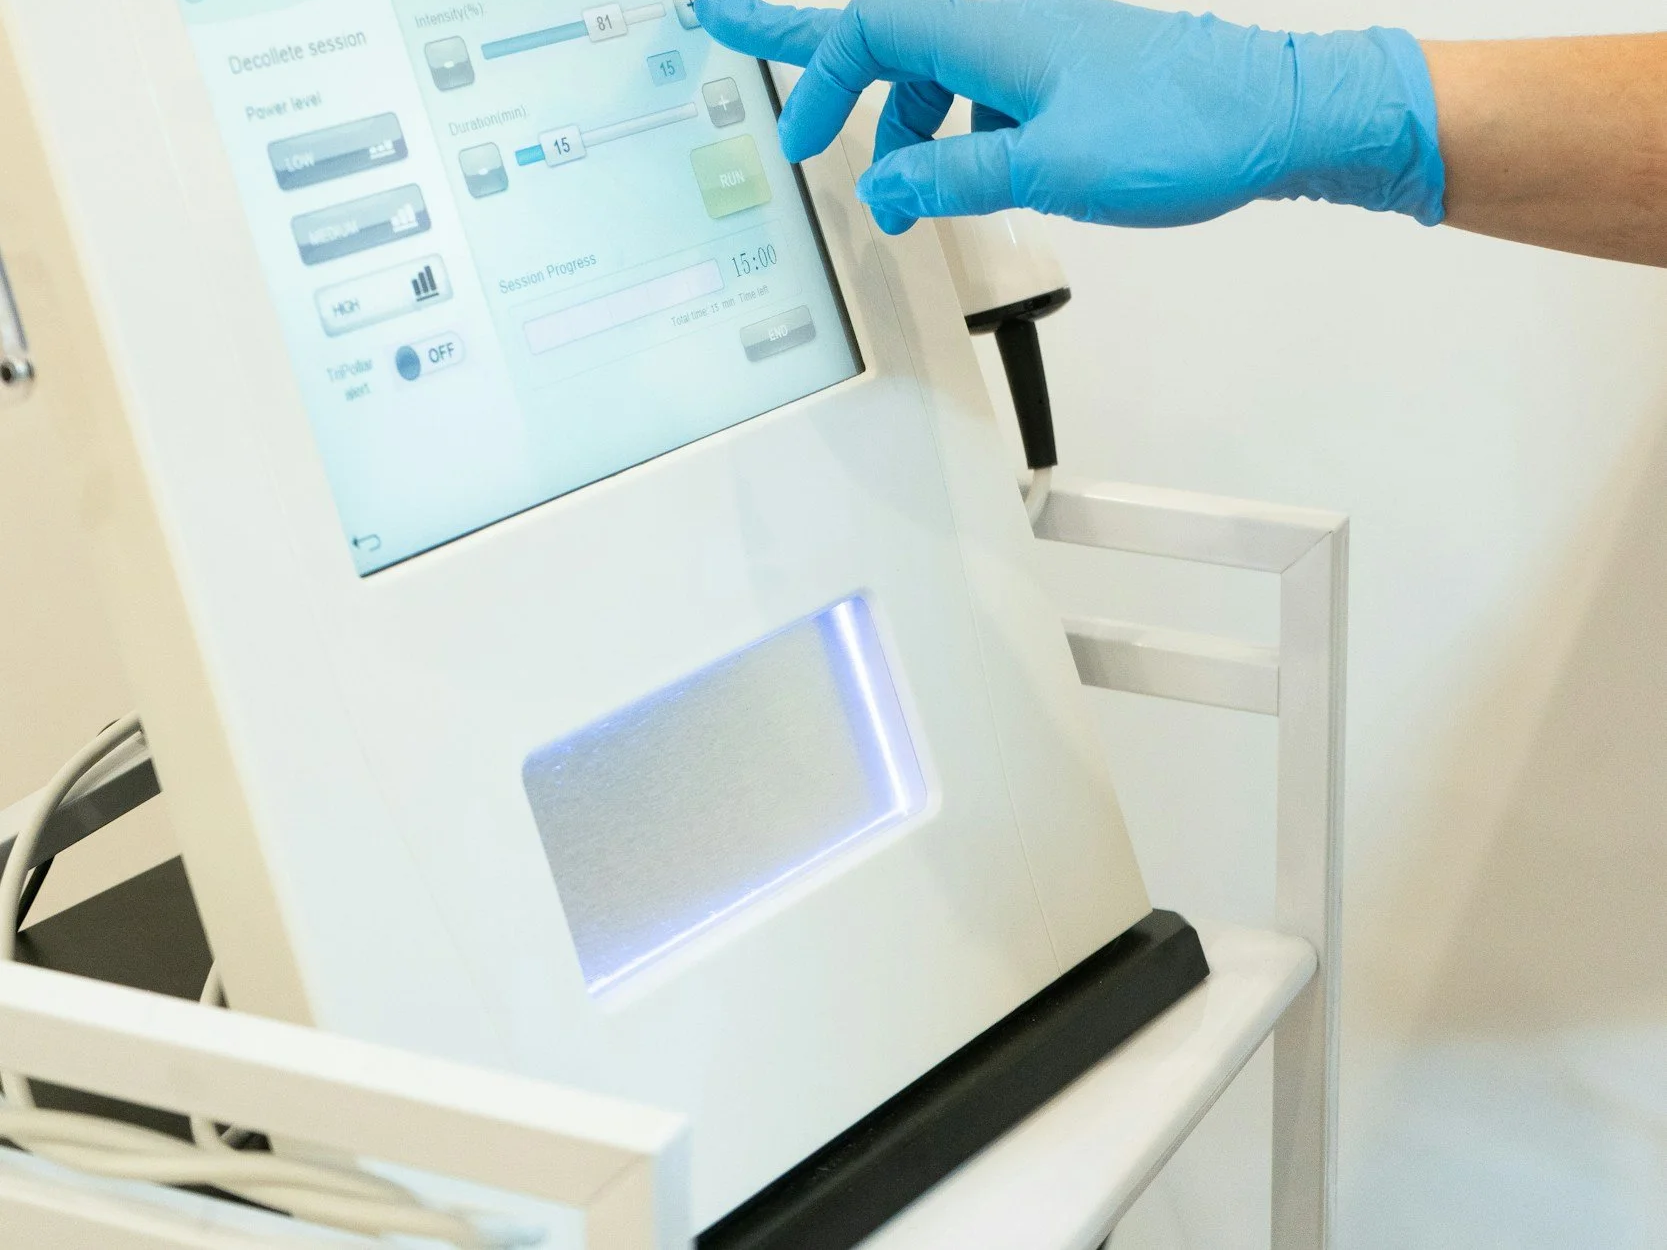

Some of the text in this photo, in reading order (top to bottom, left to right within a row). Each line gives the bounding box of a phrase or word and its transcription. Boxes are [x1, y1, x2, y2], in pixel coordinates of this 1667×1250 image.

[596, 14, 613, 31] 81
[228, 31, 368, 75] Decollete session
[659, 59, 676, 77] 15
[245, 91, 323, 122] Power level
[553, 137, 571, 156] 15
[719, 170, 745, 188] RUN
[731, 244, 777, 277] 15:00
[499, 253, 597, 295] Session Progress
[332, 299, 361, 317] HIGH
[670, 313, 690, 328] Total
[738, 291, 756, 303] Time
[768, 324, 789, 342] END
[428, 342, 456, 364] OFF
